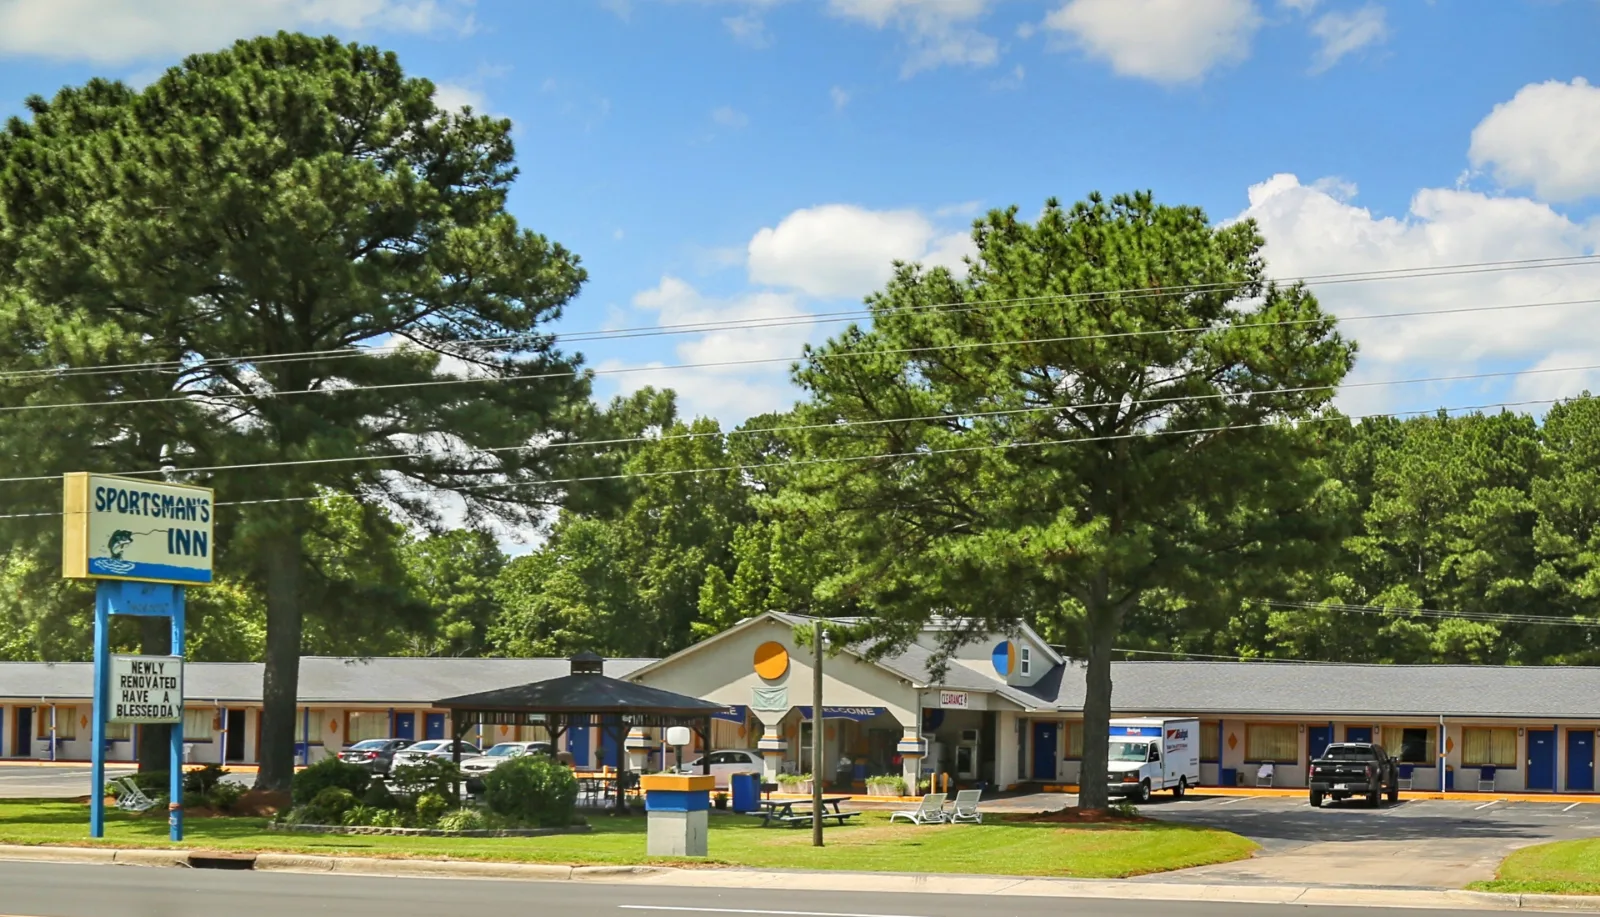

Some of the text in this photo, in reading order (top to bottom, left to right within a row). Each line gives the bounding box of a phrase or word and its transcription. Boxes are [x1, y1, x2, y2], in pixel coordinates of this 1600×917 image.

[95, 486, 209, 523] SPORTSMAN'S
[167, 527, 208, 557] INN
[131, 661, 165, 675] NEWLY
[120, 675, 177, 689] RENOVATED
[122, 690, 170, 703] HAVE A
[811, 706, 876, 717] ELCOME
